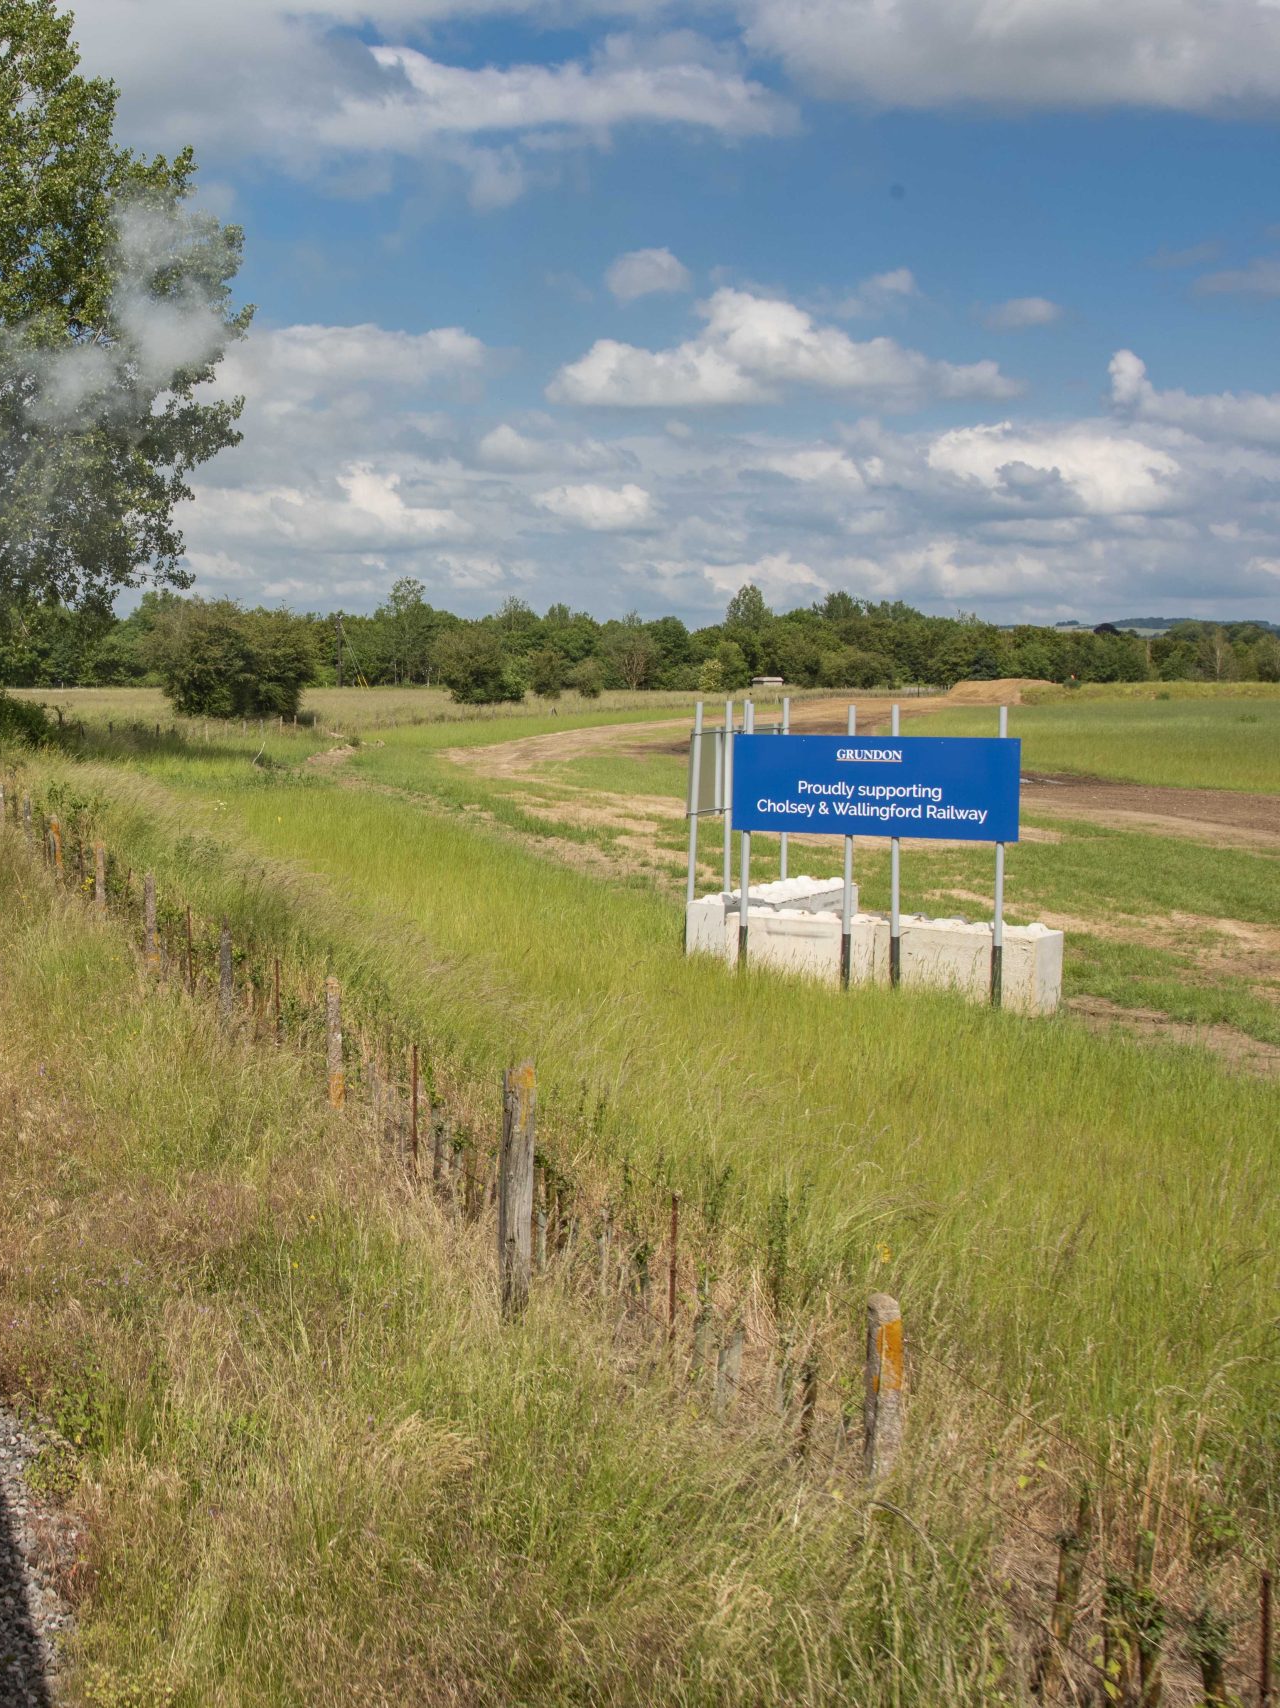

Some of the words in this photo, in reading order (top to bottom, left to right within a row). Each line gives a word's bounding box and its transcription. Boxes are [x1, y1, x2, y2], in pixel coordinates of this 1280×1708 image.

[837, 749, 902, 761] GRUNDON
[798, 781, 854, 799] Proudly
[858, 784, 942, 801] supporting
[757, 799, 815, 817] Cholsey
[819, 802, 830, 815] &
[833, 801, 921, 821] Wallingford
[926, 805, 988, 824] Railway
